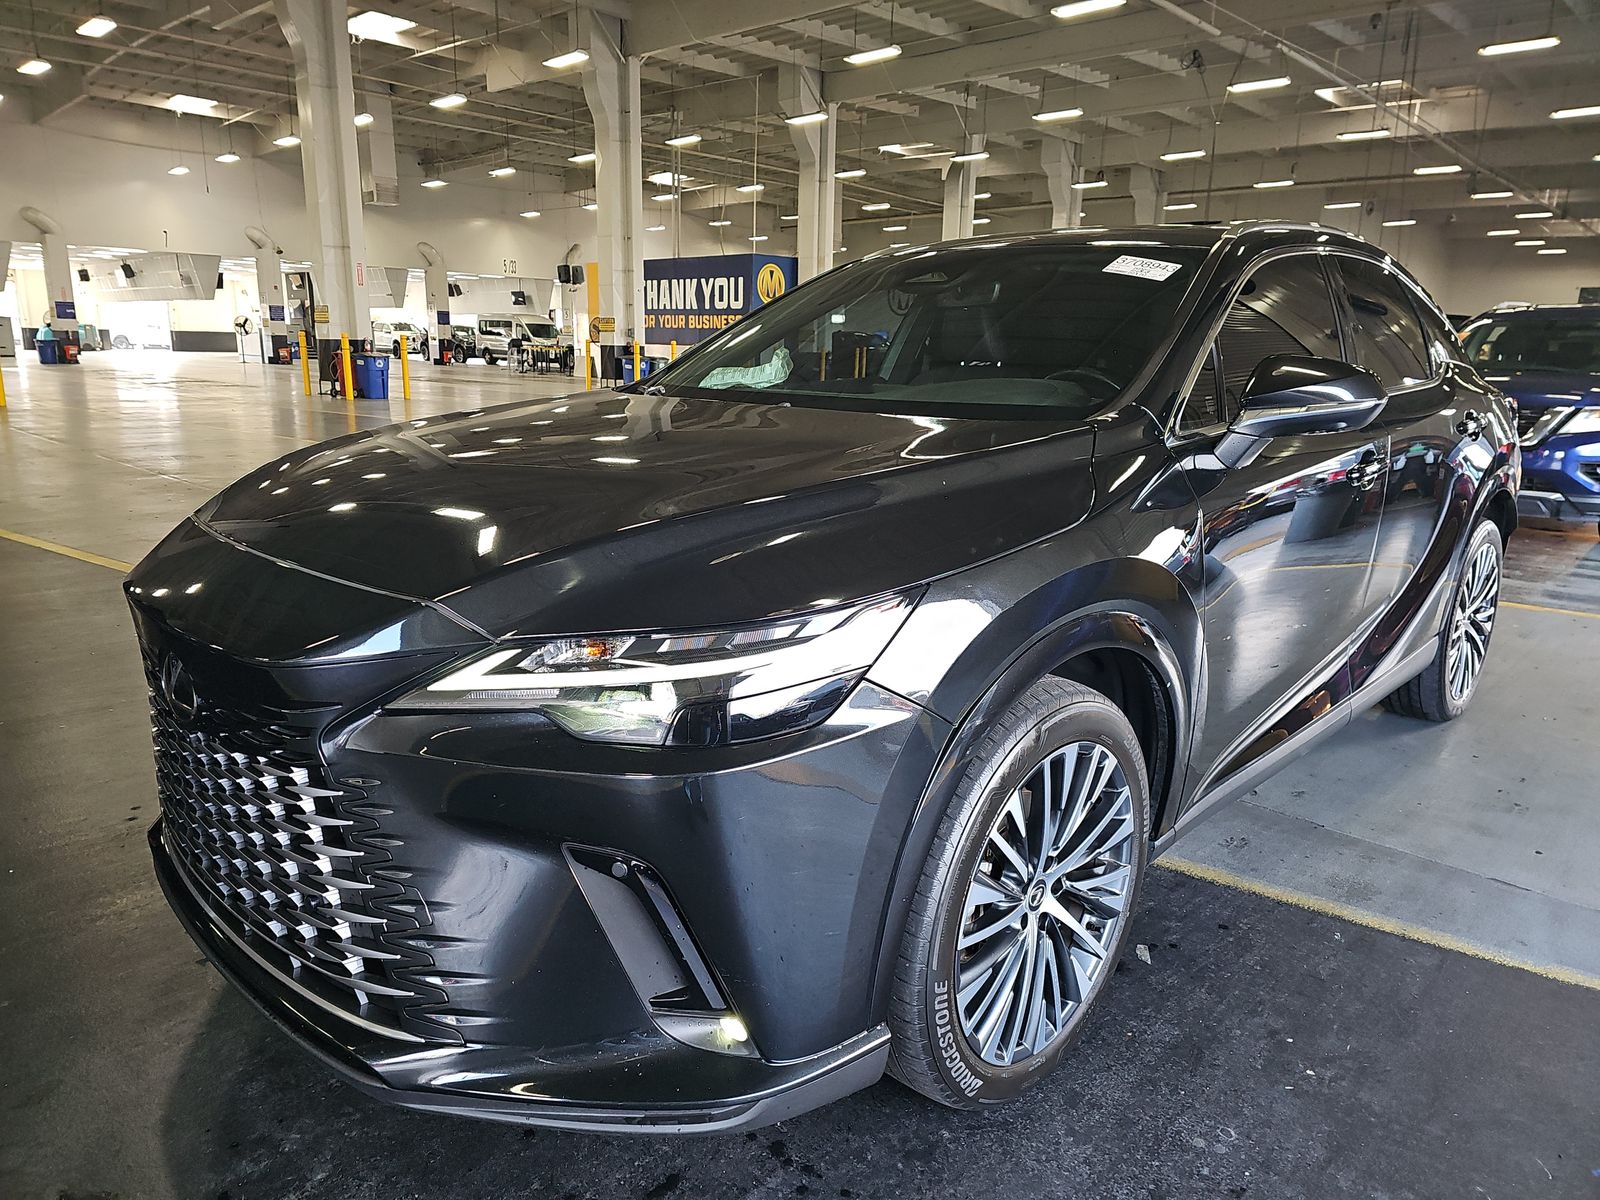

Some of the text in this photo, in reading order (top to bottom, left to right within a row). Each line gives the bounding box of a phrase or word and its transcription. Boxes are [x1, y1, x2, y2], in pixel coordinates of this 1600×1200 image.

[1116, 257, 1178, 273] 3708943
[701, 276, 744, 310] YOU
[659, 315, 686, 329] YOUR
[934, 980, 984, 1098] BRIDGESTONE
